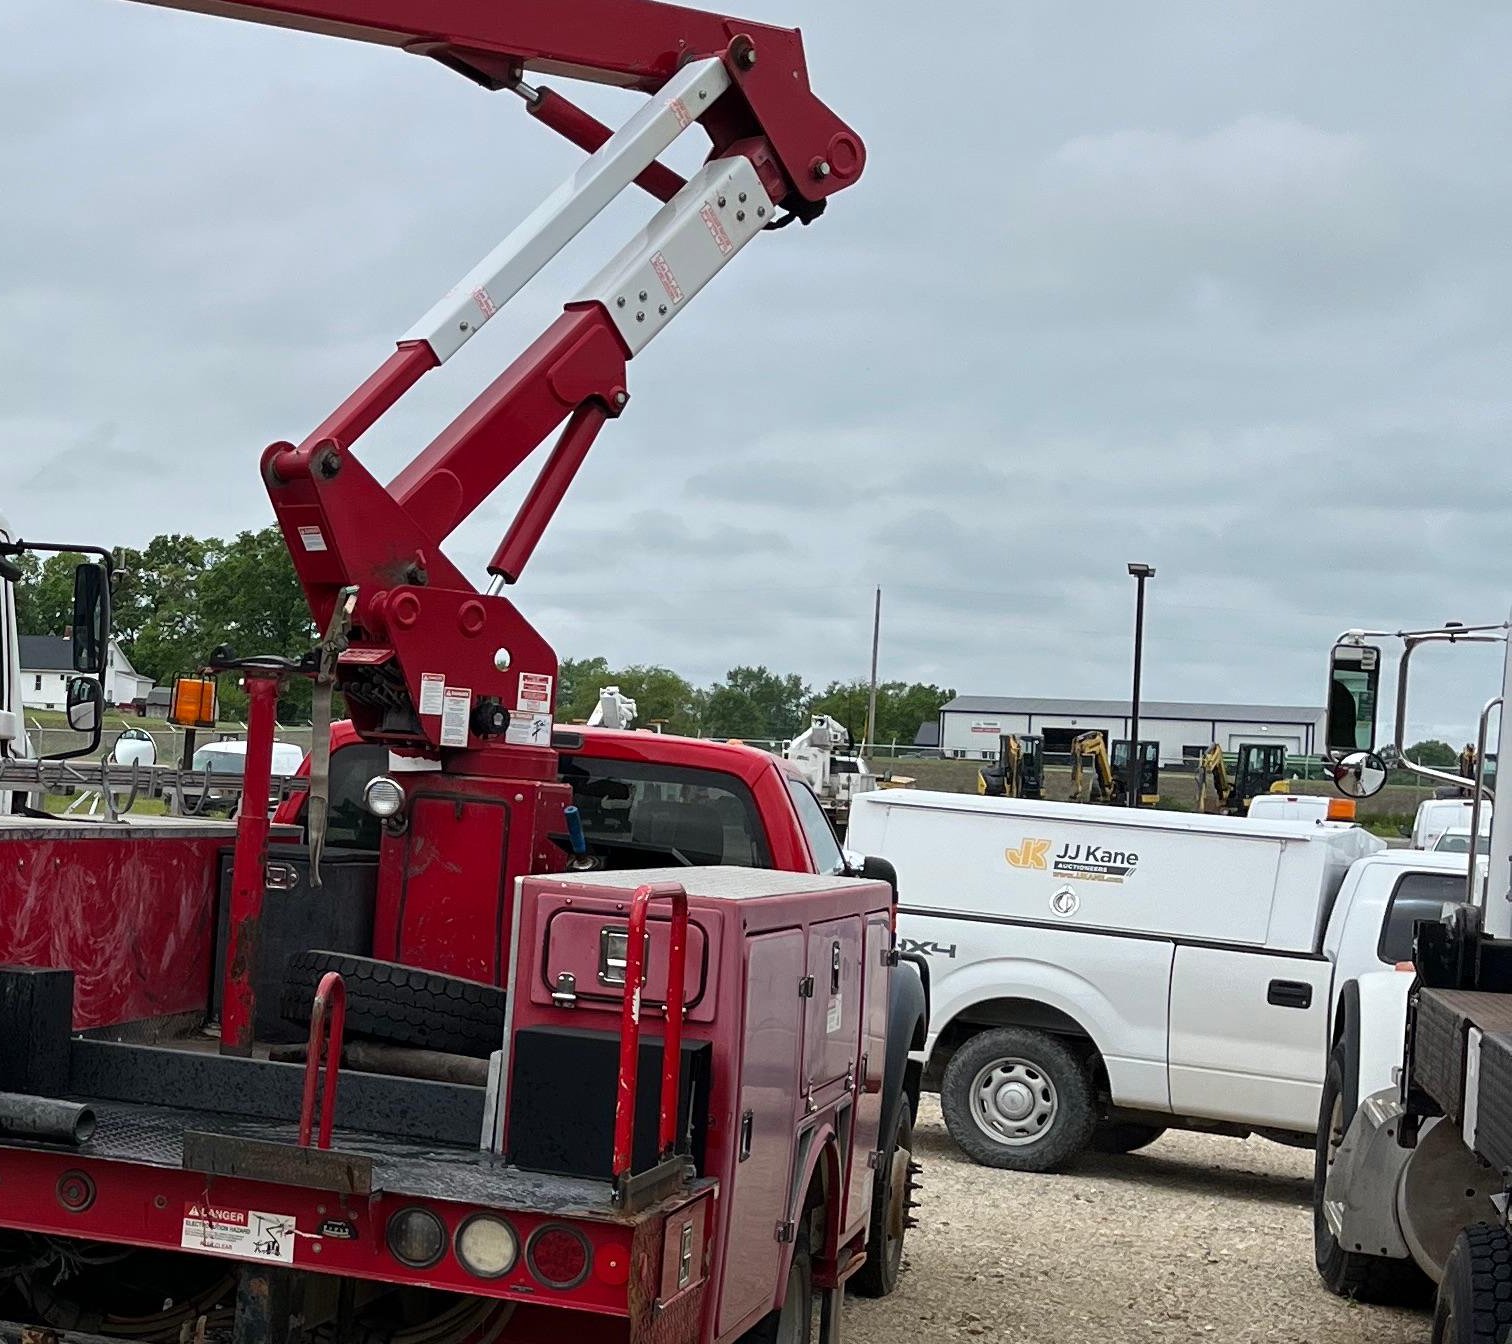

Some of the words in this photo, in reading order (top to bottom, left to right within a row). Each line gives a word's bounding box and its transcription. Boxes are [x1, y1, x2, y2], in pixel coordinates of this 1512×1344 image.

[1056, 843, 1081, 860] JJ
[1085, 845, 1139, 865] Kane
[1057, 862, 1108, 873] AUCTIONEERS
